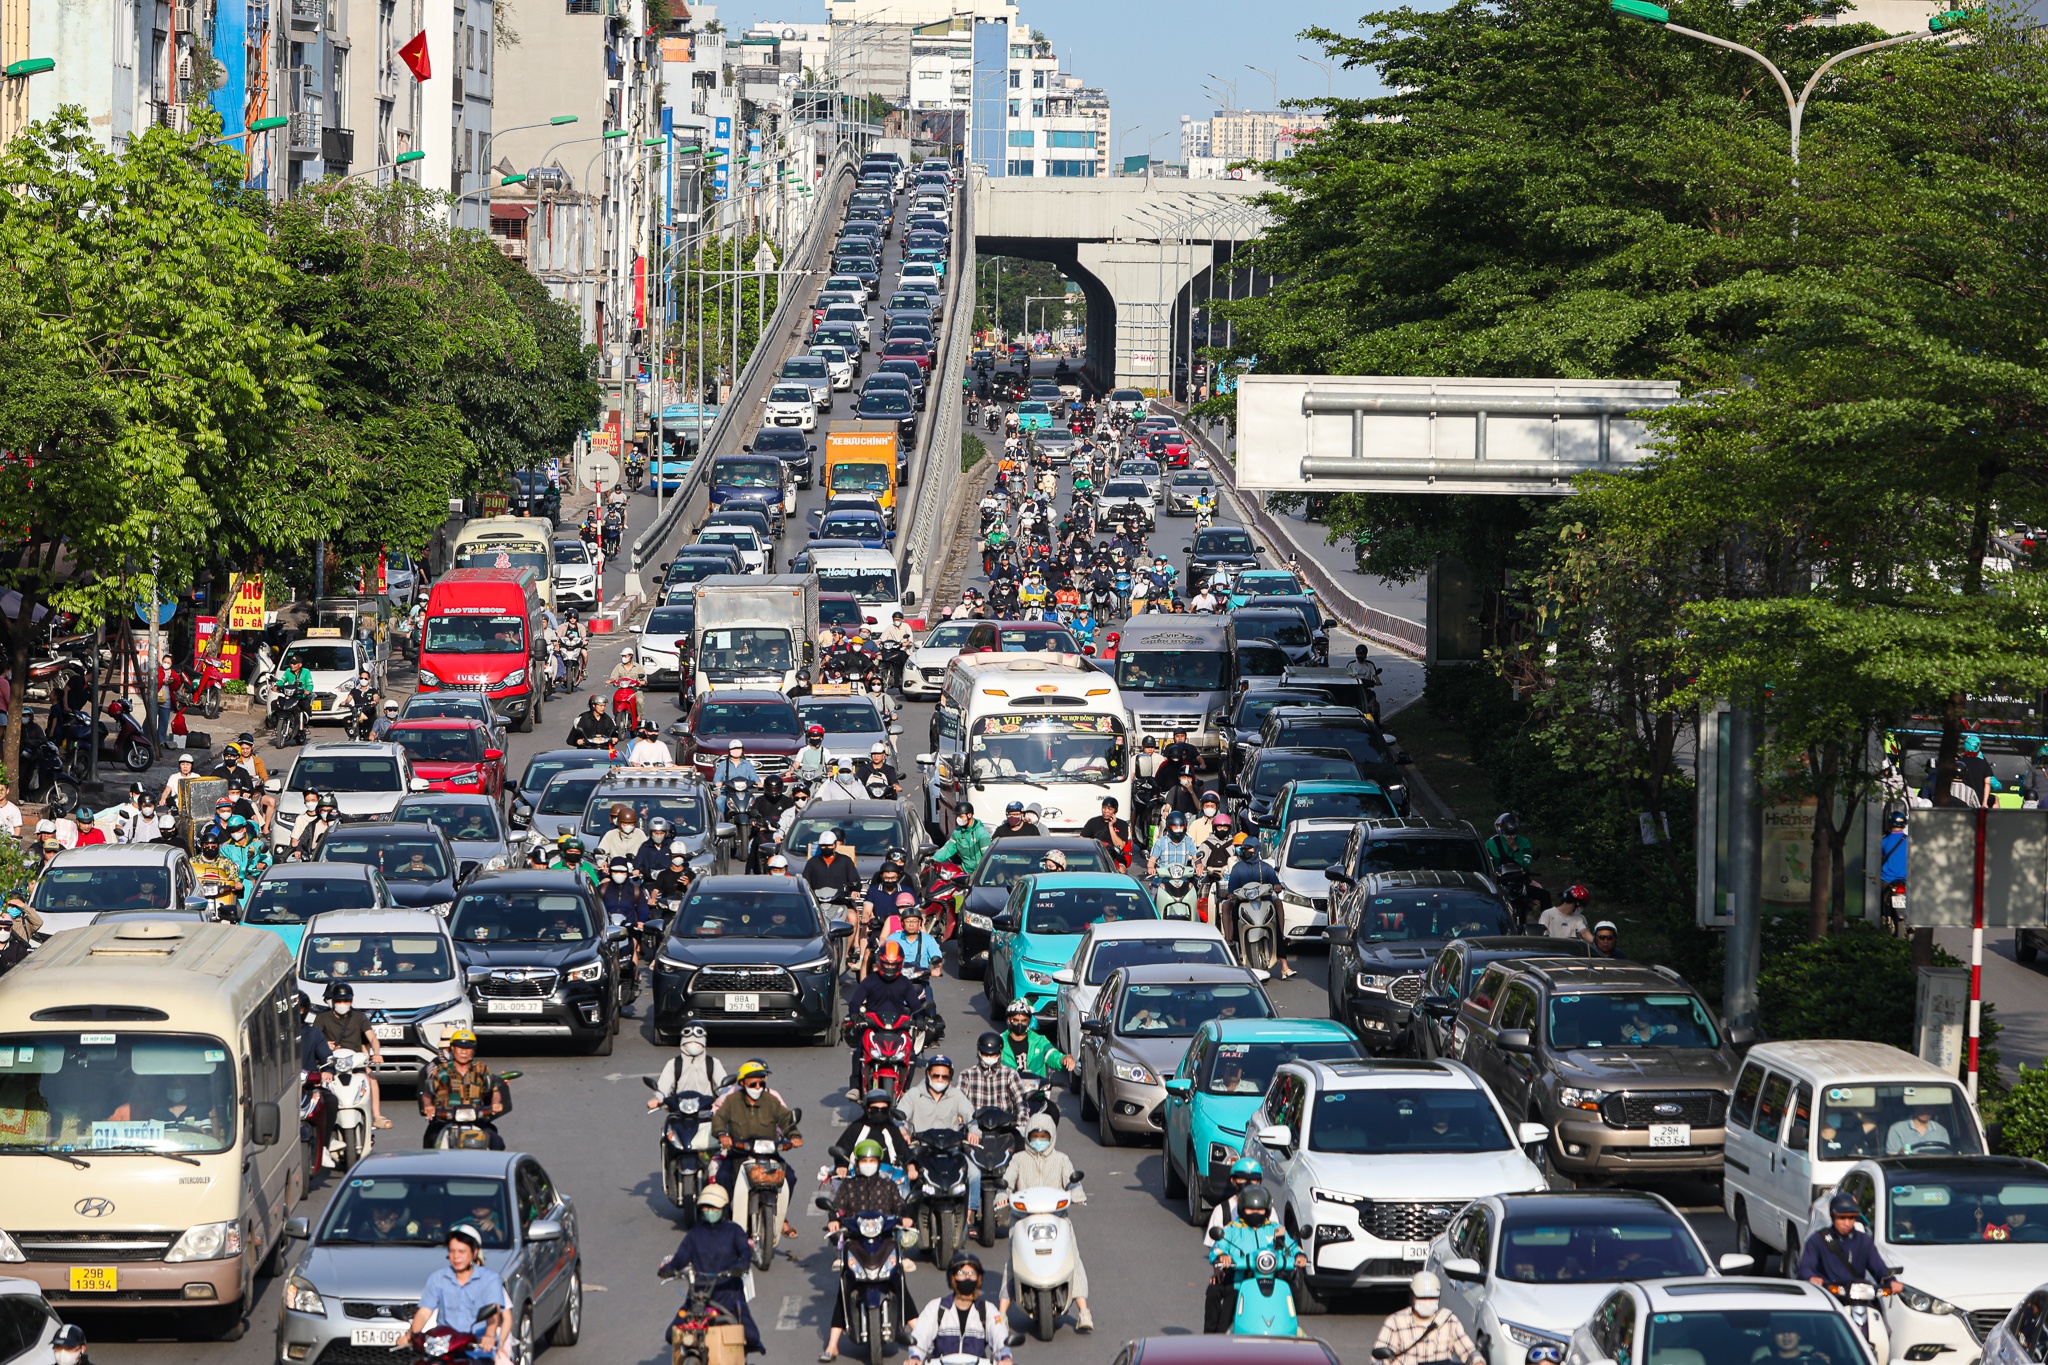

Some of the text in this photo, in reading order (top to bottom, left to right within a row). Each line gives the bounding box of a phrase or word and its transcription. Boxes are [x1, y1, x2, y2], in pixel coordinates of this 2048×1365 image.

[1002, 716, 1023, 725] VIP
[374, 1027, 403, 1038] 62.93
[83, 1268, 104, 1279] 29B
[76, 1279, 112, 1290] 139.94
